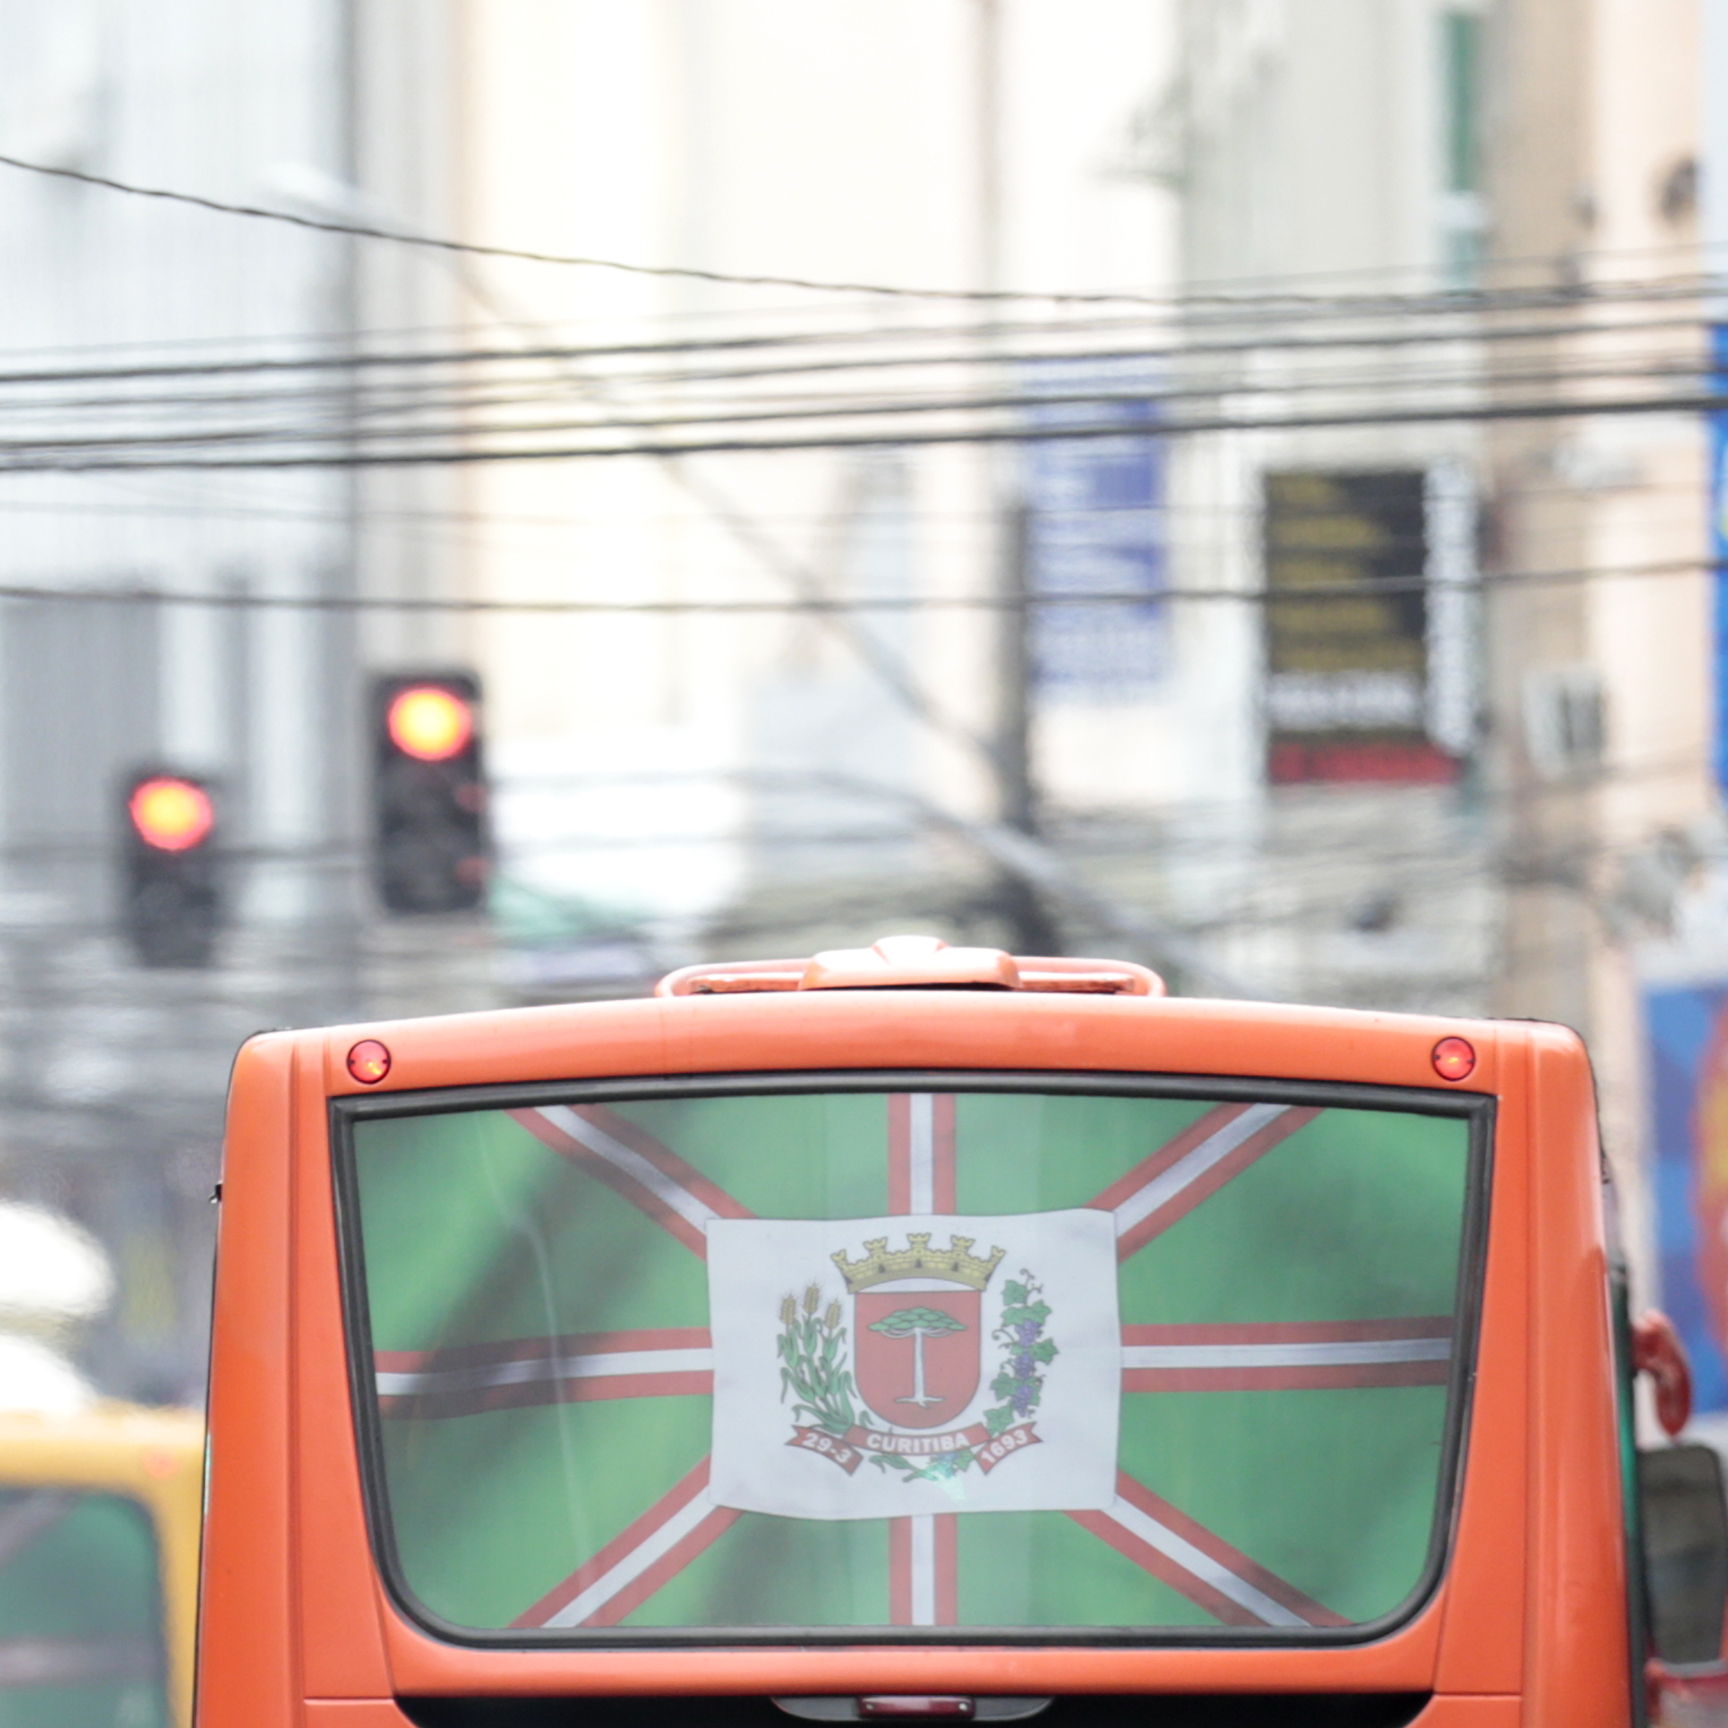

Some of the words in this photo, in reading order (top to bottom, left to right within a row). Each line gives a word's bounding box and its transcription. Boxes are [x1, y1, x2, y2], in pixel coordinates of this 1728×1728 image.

[800, 1431, 853, 1464] 29-3
[865, 1432, 971, 1453] CURITIBA
[980, 1429, 1029, 1464] 1693
